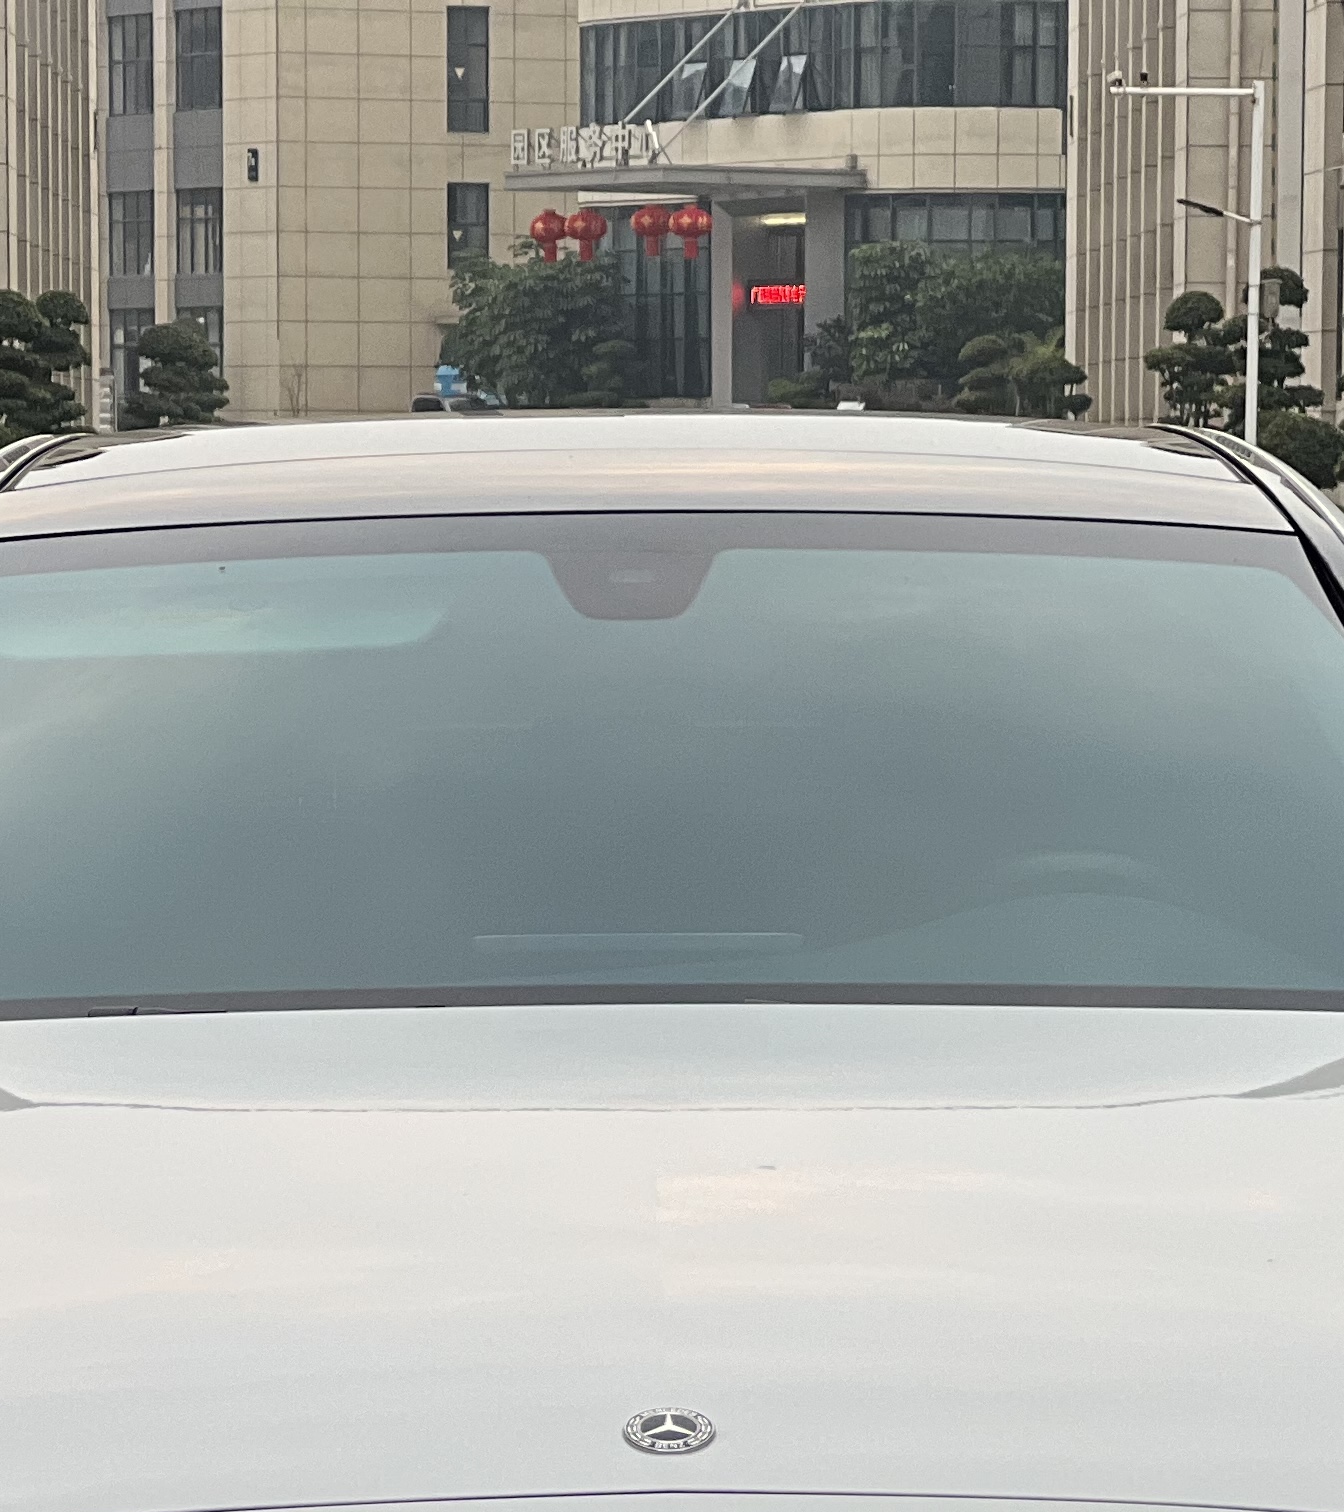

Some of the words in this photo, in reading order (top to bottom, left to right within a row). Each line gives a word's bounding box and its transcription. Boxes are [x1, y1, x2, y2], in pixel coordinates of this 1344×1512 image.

[511, 120, 660, 165] 园区服务中心
